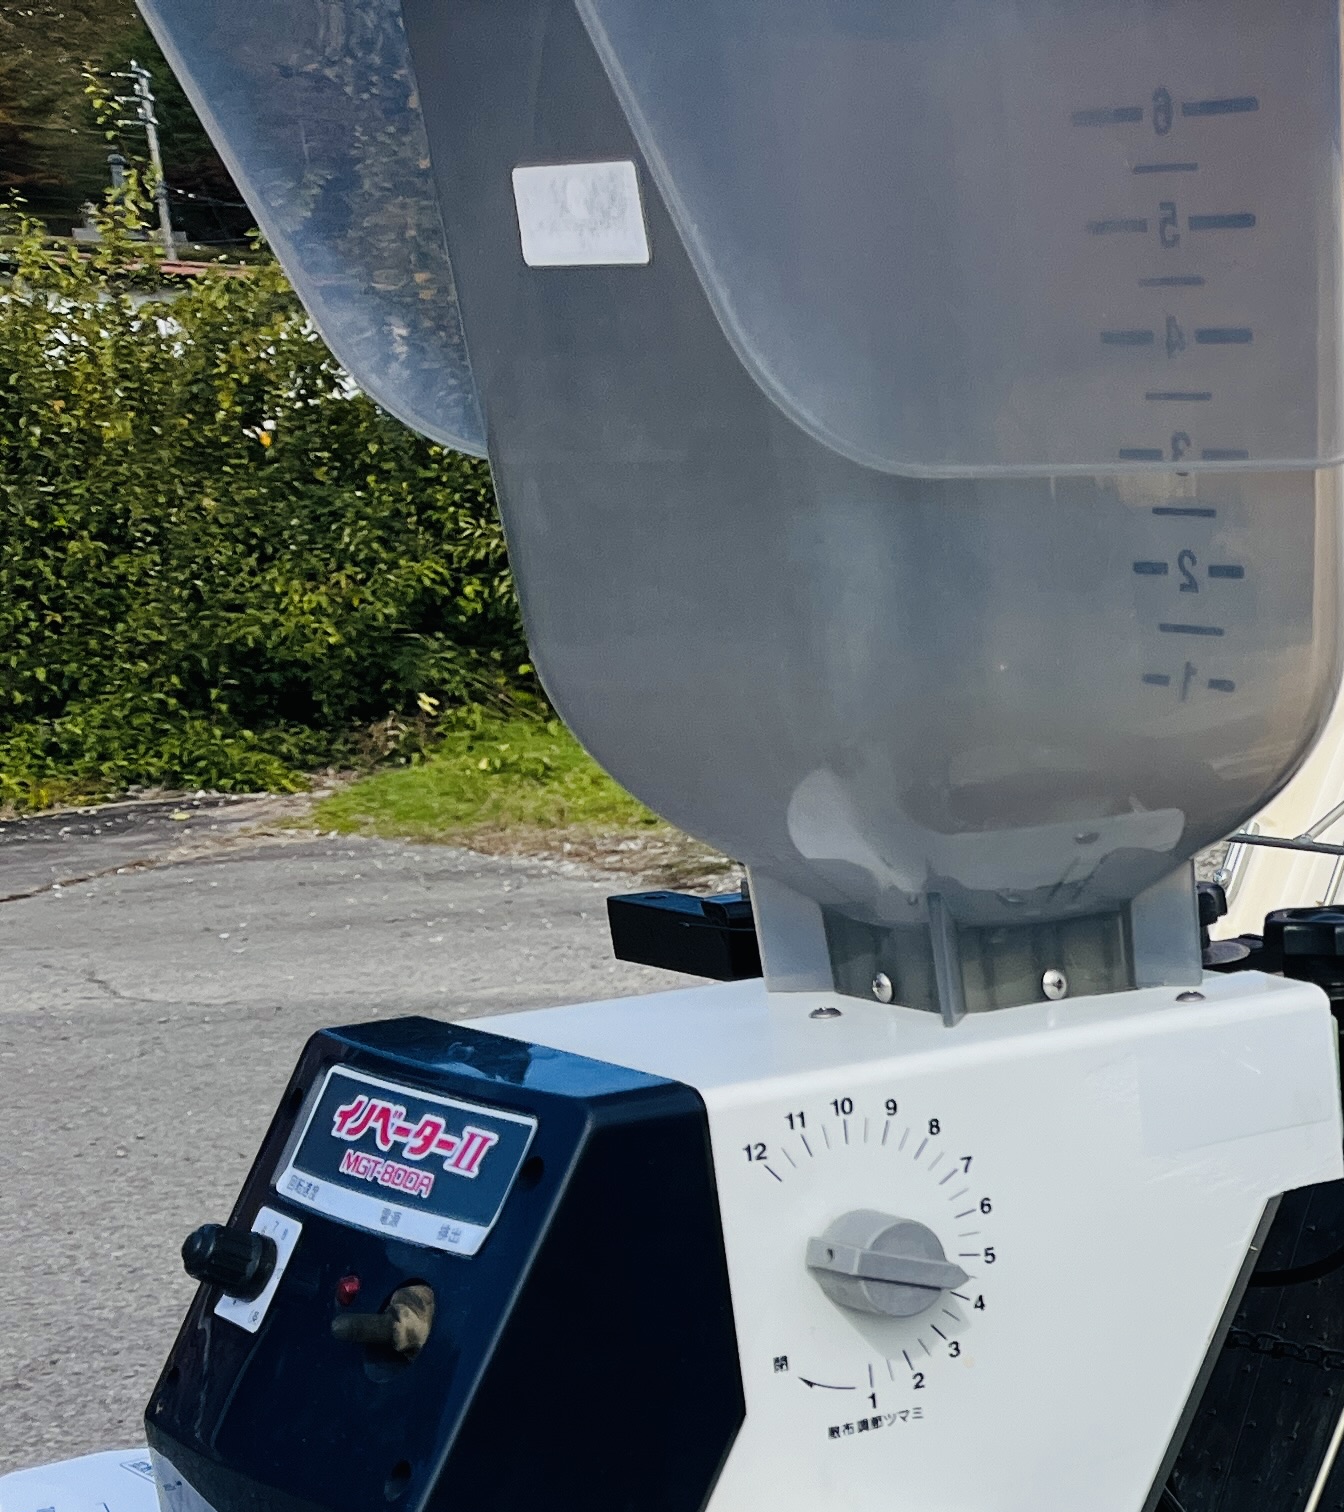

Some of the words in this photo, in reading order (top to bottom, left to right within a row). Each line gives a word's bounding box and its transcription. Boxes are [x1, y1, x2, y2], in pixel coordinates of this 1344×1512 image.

[831, 1097, 853, 1115] 10
[885, 1099, 897, 1116] 9
[785, 1111, 807, 1129] 11
[928, 1118, 941, 1135] 8
[743, 1142, 767, 1162] 12
[961, 1156, 973, 1173] 7
[980, 1198, 992, 1214] 6
[984, 1247, 996, 1263] 5
[974, 1295, 986, 1311] 4
[948, 1341, 961, 1358] 3
[913, 1373, 925, 1390] 2
[868, 1393, 878, 1409] 1
